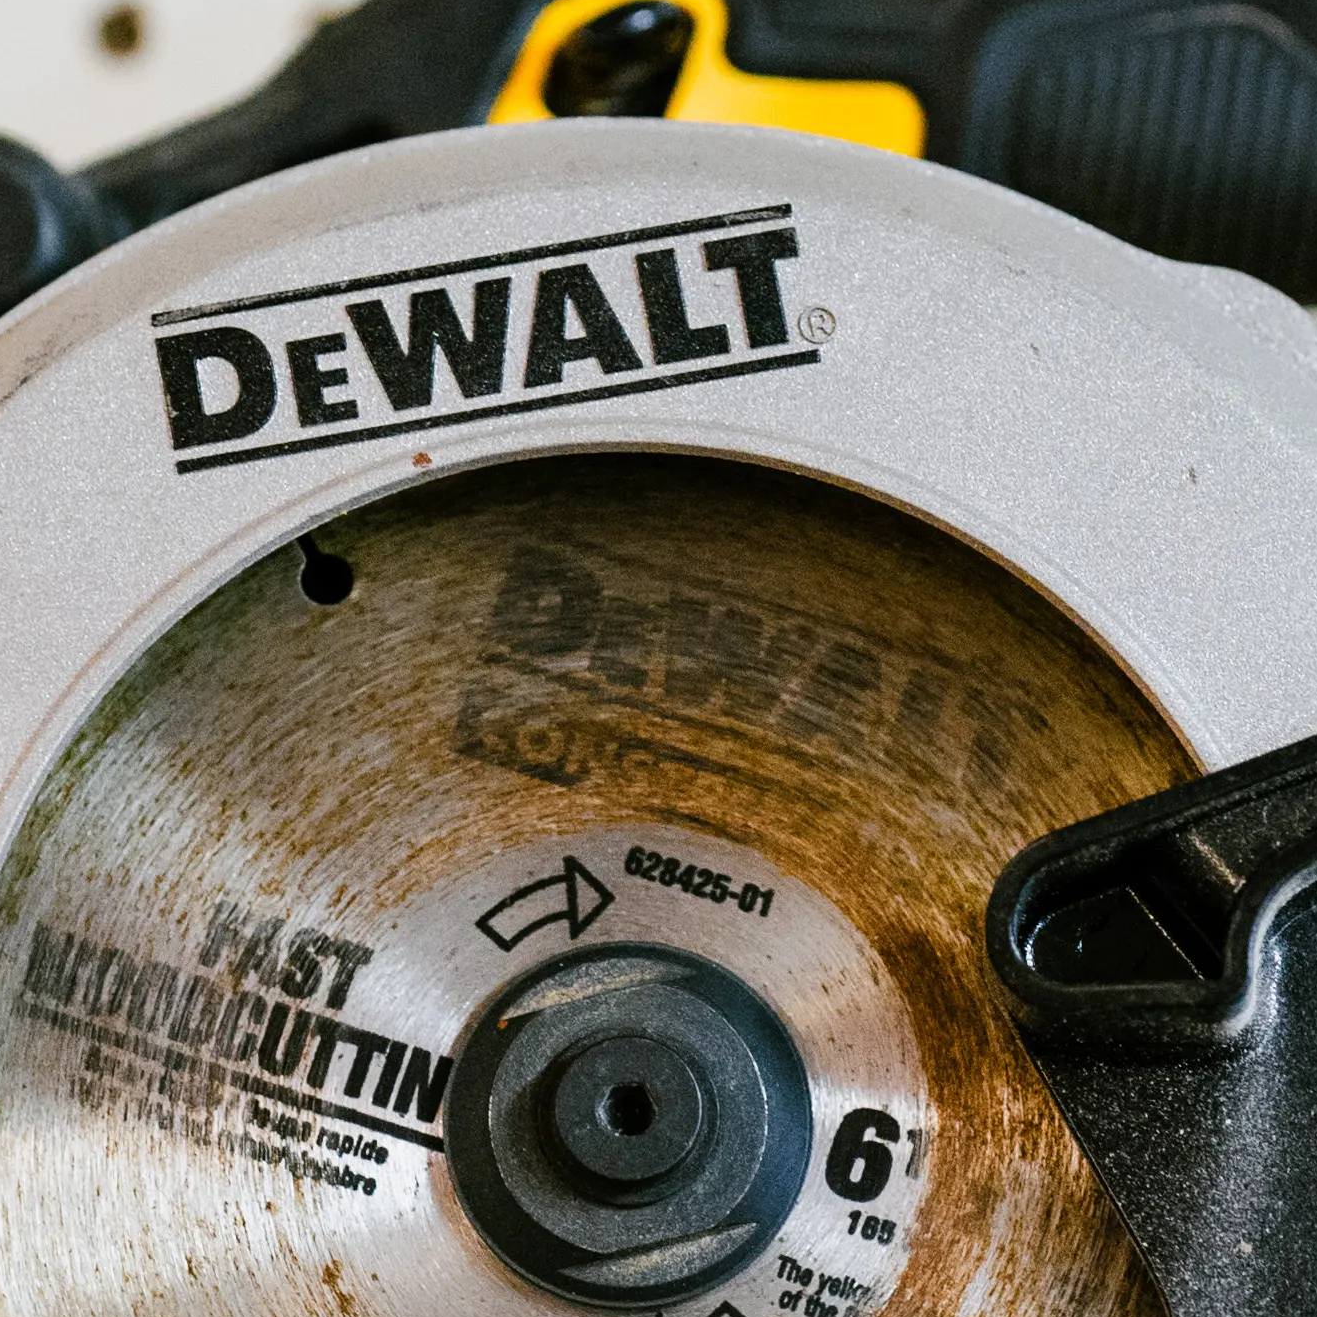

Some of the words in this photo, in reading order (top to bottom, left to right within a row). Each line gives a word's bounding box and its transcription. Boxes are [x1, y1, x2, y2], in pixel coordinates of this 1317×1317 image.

[624, 845, 775, 917] 628425-01
[23, 921, 454, 1123] WOODCUTTIN
[778, 1254, 814, 1287] The
[778, 1290, 804, 1313] of
